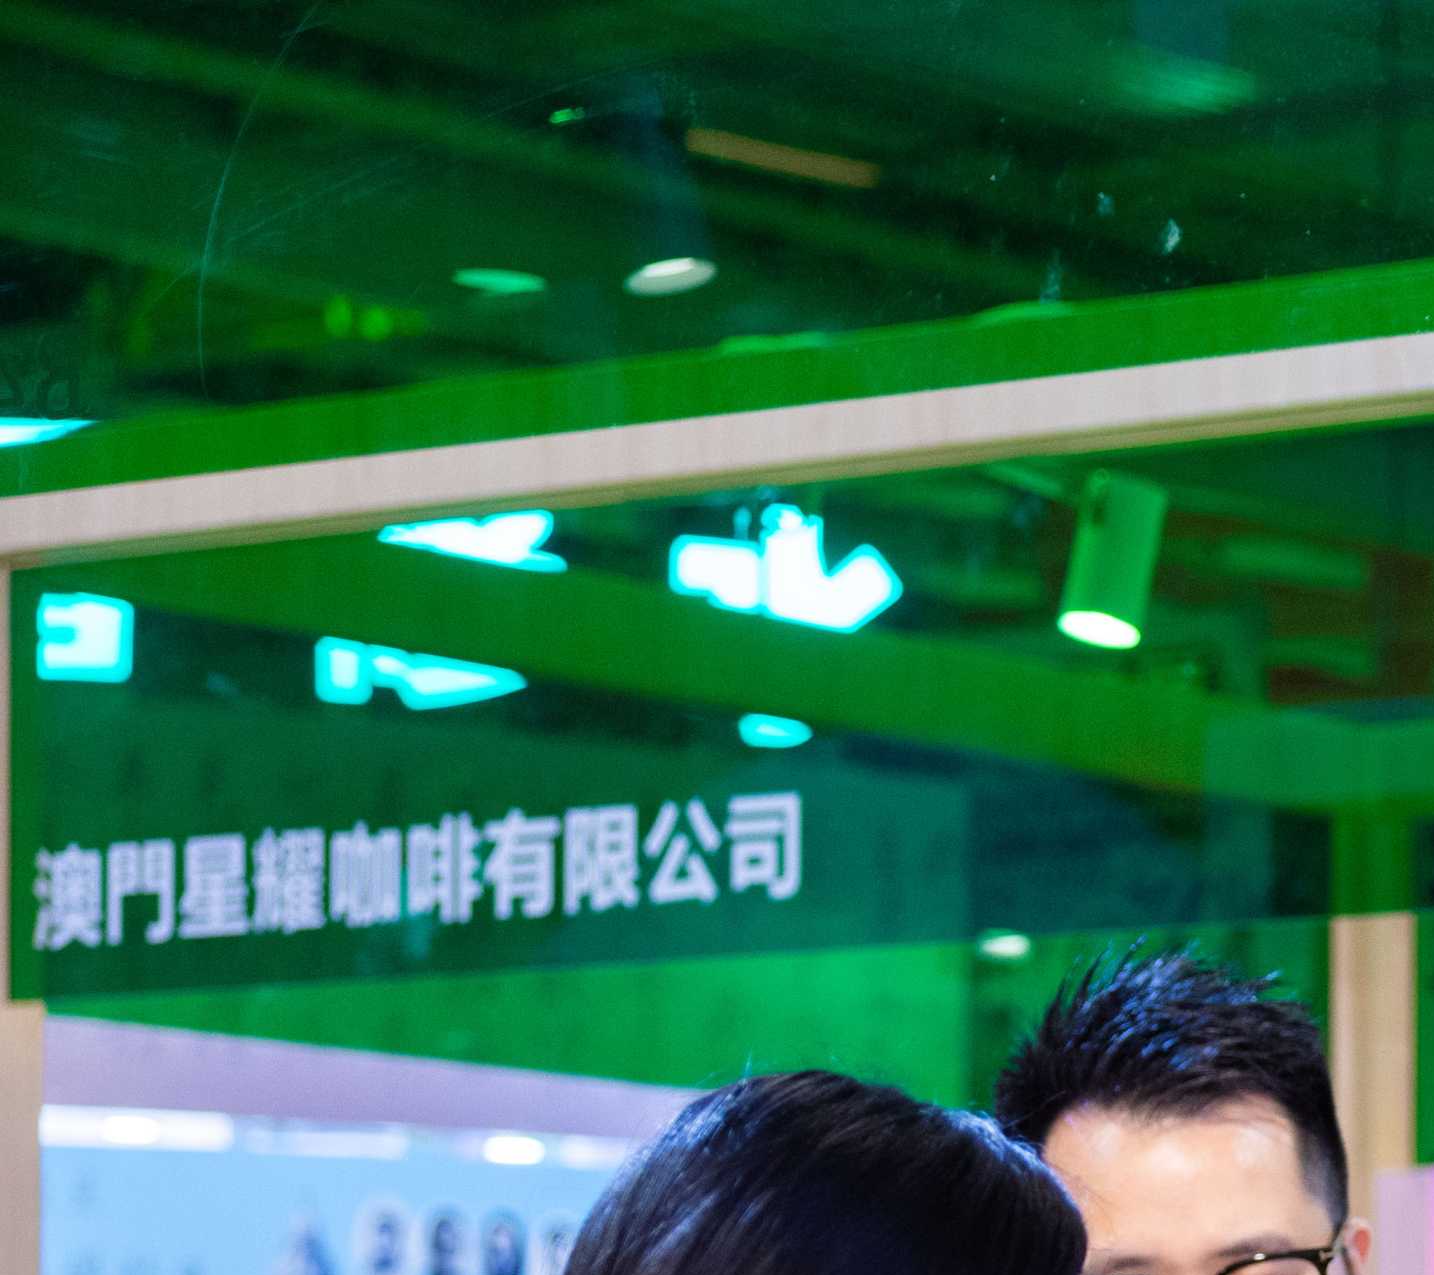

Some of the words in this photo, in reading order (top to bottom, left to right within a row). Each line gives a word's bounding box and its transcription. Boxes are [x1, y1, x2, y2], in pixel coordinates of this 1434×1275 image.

[33, 791, 803, 951] 澳門星耀咖啡有限公司
